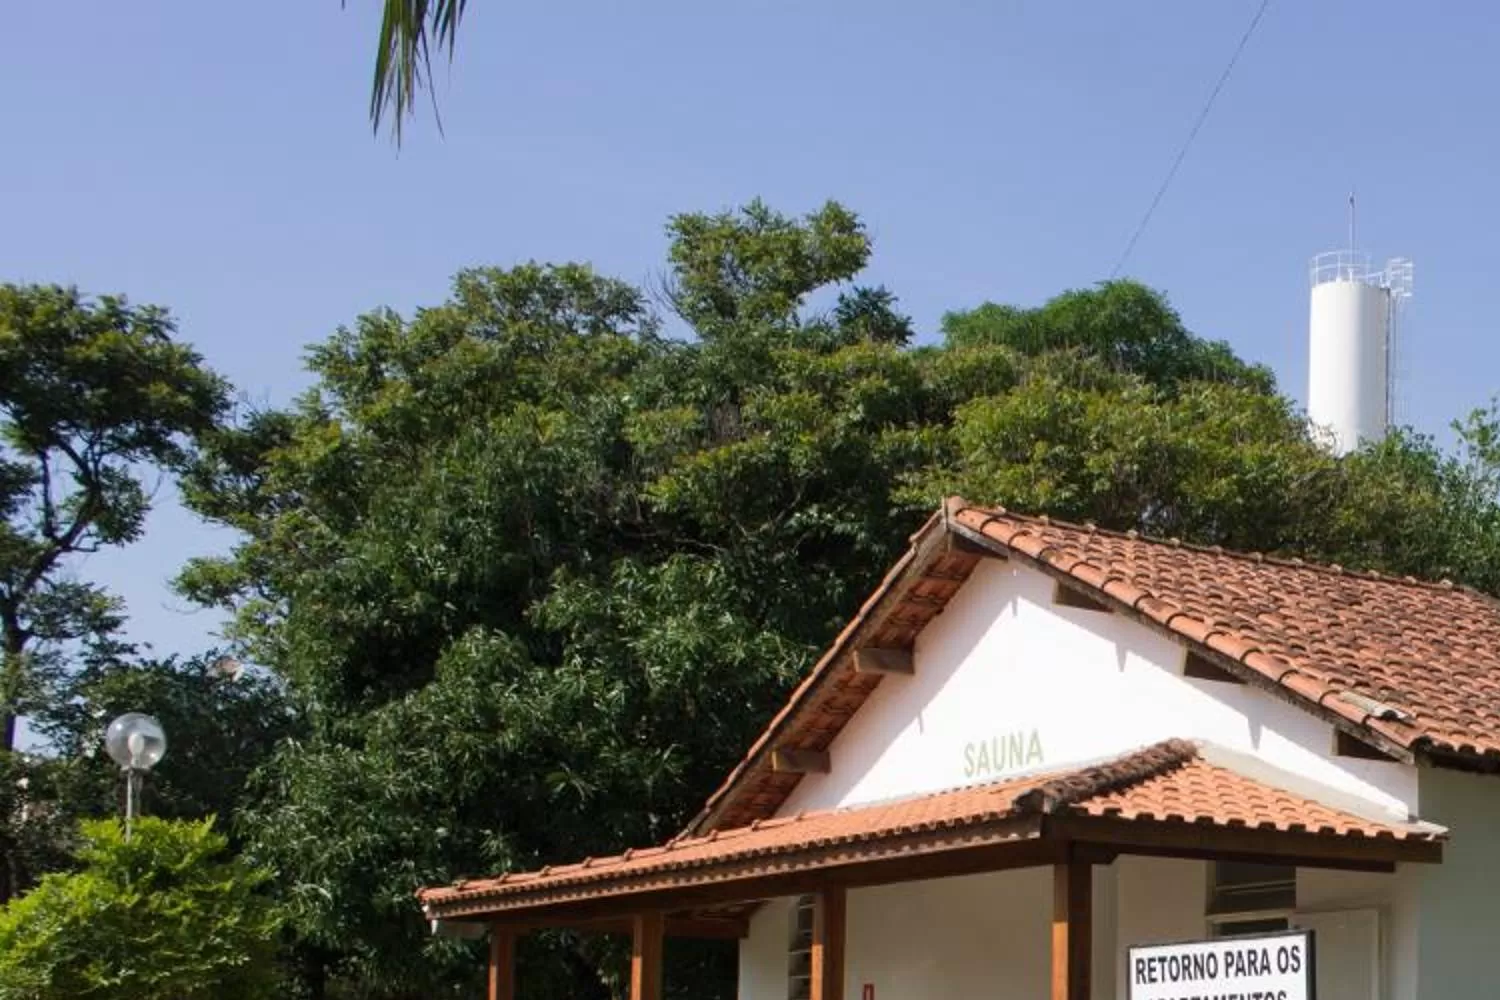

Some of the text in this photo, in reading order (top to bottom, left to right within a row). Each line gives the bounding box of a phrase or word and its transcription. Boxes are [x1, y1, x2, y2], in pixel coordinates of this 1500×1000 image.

[963, 728, 1044, 778] SAUNA
[1135, 945, 1301, 984] RETORNO PARA OS
